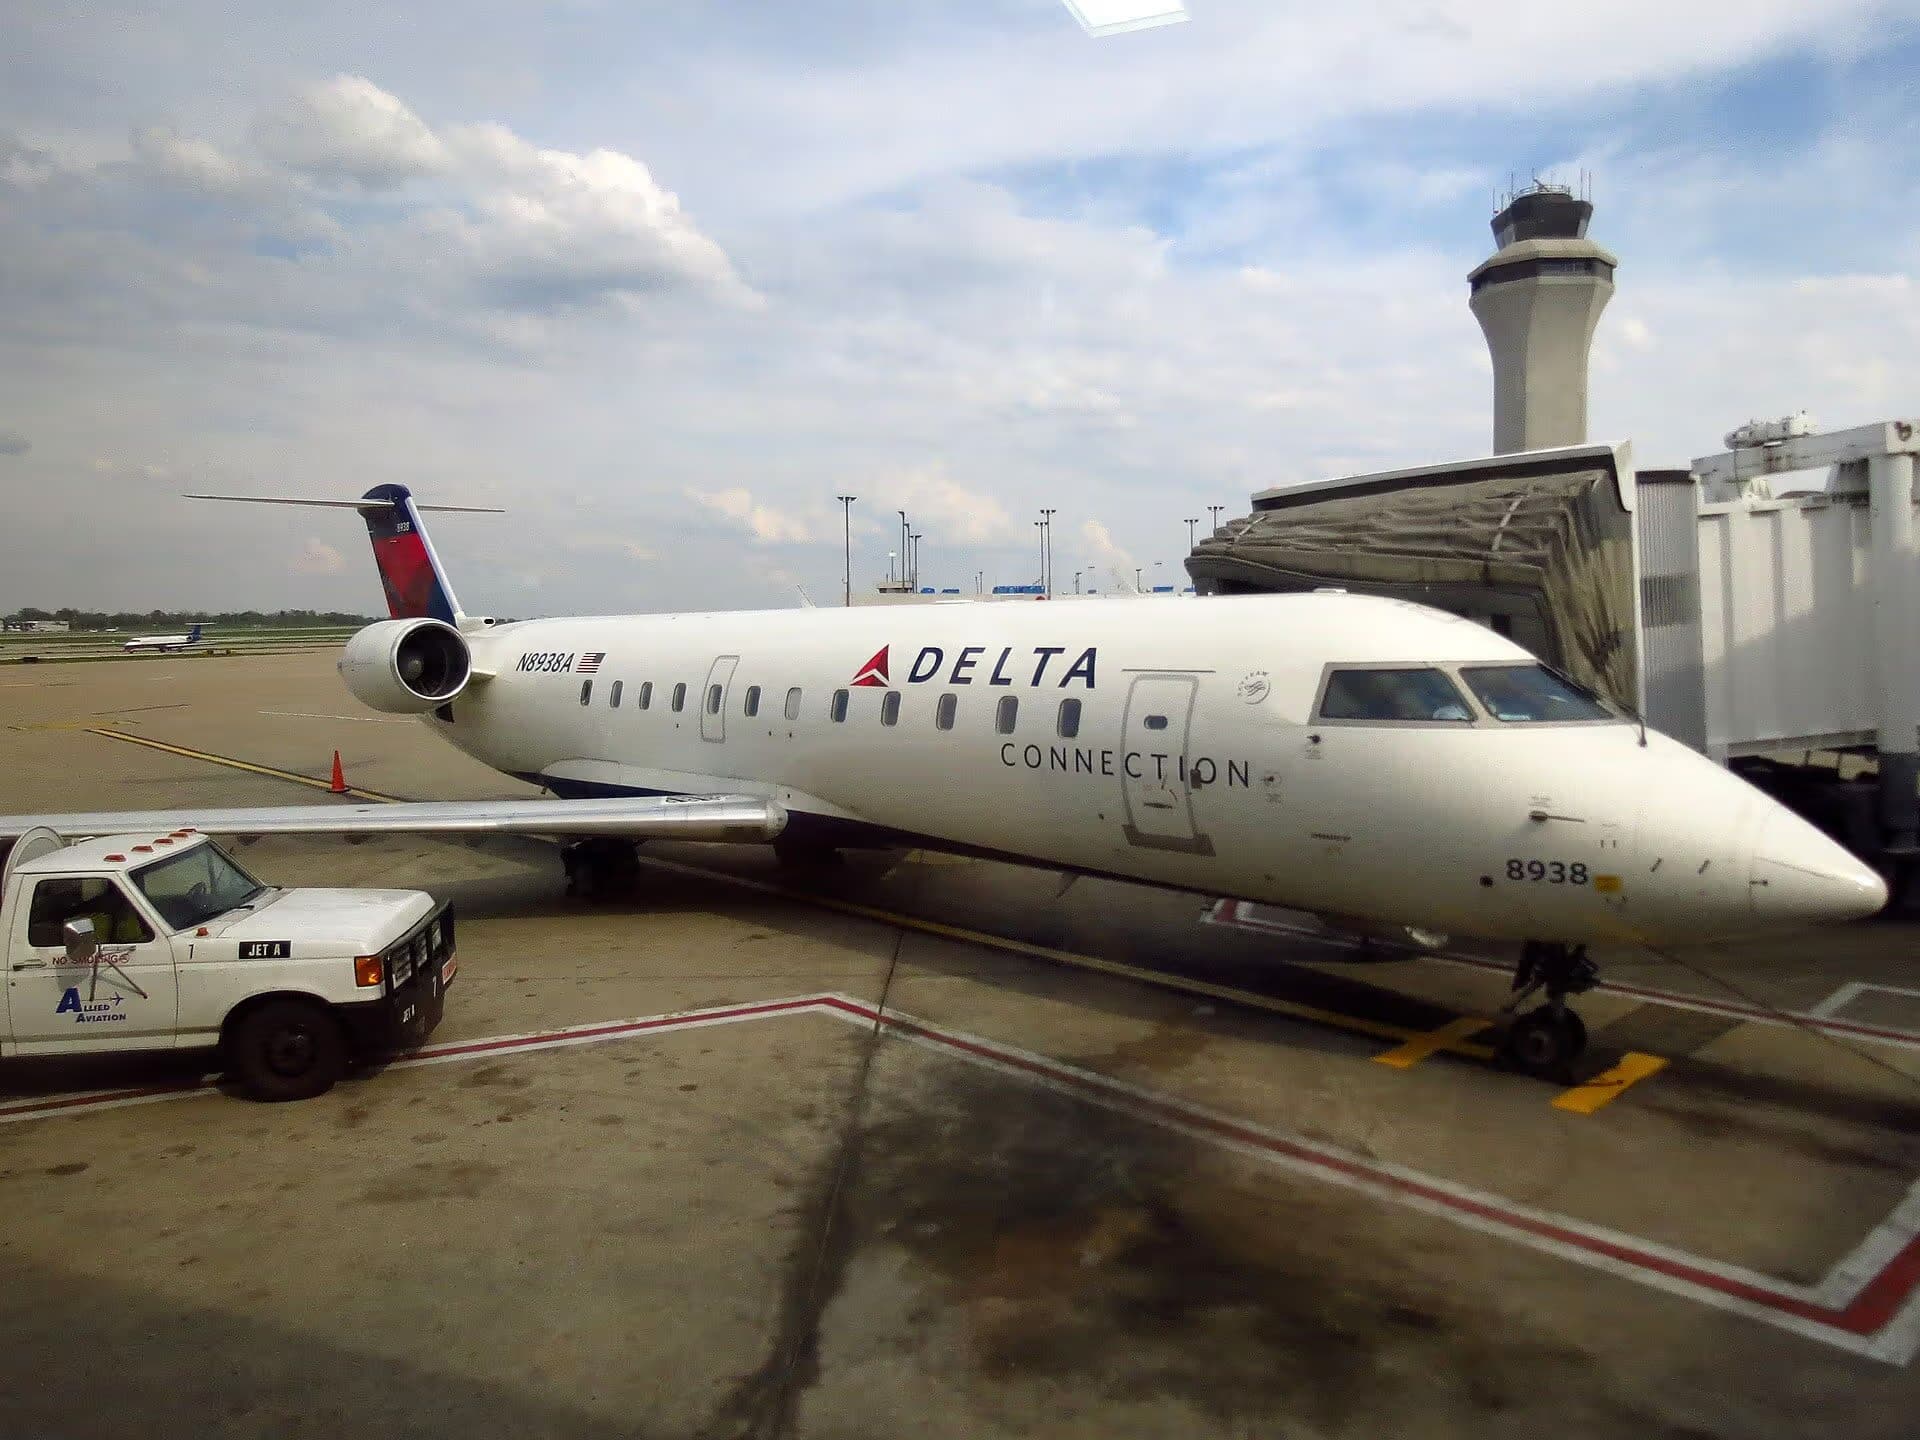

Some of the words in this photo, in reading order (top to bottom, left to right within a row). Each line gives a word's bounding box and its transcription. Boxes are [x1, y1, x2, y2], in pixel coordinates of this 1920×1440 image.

[516, 652, 575, 672] N8938A
[907, 647, 1098, 689] DELTA
[1001, 743, 1249, 788] CONNECTION
[1506, 858, 1589, 885] 8938
[52, 956, 68, 966] NO
[248, 944, 269, 957] JET
[273, 943, 281, 956] A
